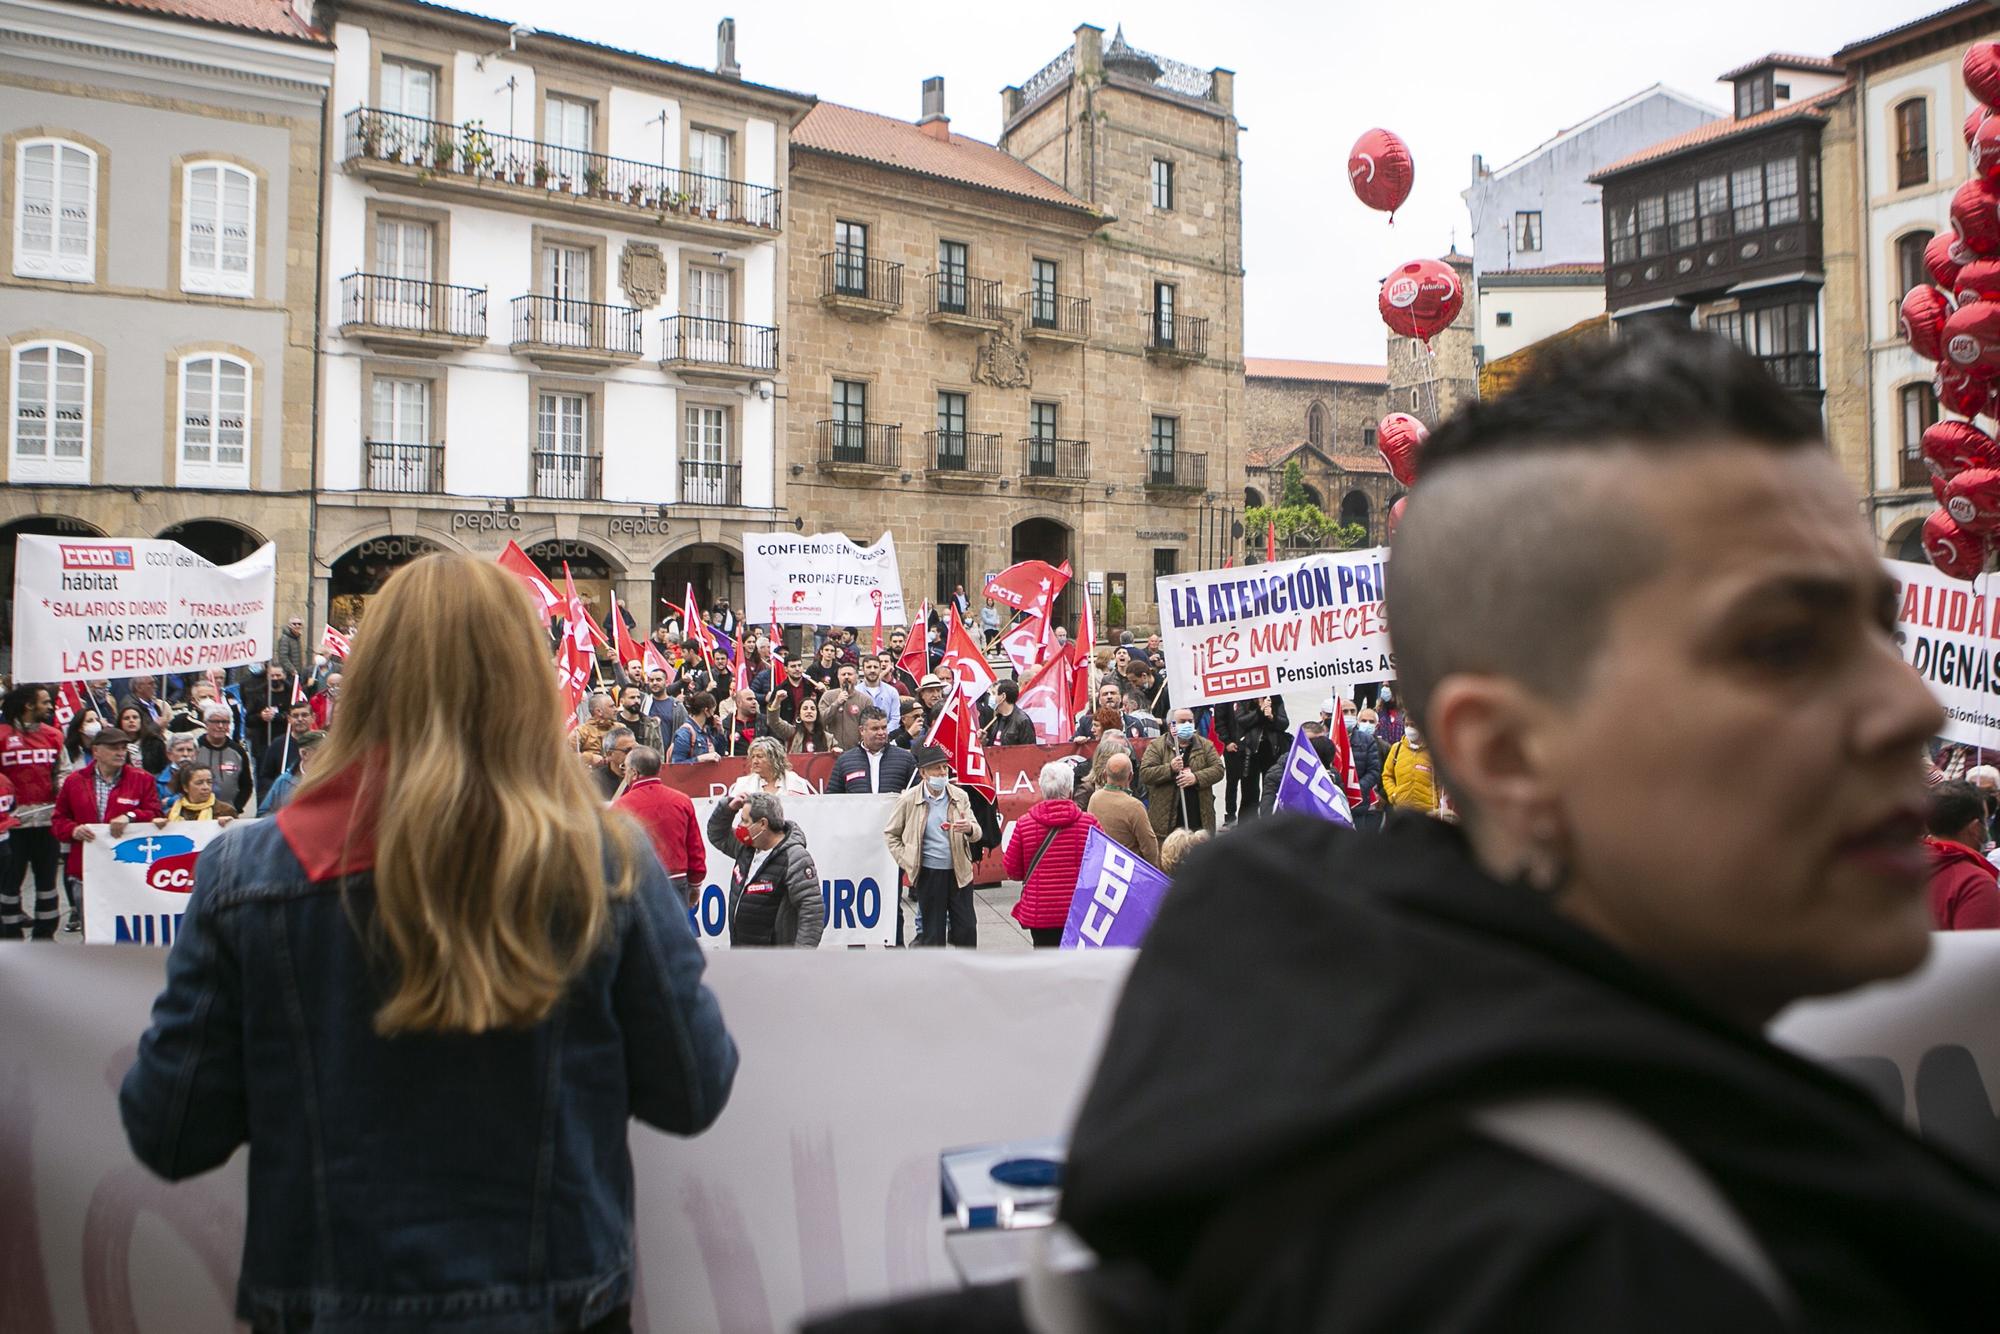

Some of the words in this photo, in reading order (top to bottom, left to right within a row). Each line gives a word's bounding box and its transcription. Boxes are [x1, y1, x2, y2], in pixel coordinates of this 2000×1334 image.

[1391, 281, 1415, 296] UGT
[452, 511, 522, 533] pepita
[608, 515, 671, 536] pepita
[63, 547, 115, 566] CCOO
[358, 536, 434, 560] pepita
[757, 543, 834, 556] CONFIEMOS
[836, 543, 850, 555] EN
[61, 572, 119, 591] hábitat
[788, 573, 836, 585] PROPIAS
[989, 583, 1023, 605] PCTE
[1170, 585, 1204, 629] LA
[1208, 562, 1333, 625] ATENCIÓN
[128, 600, 168, 616] DIGNOS
[1895, 580, 2000, 640] ALIDA
[88, 620, 124, 643] MÁS
[1250, 618, 1302, 658] MUY
[62, 650, 104, 674] LAS
[198, 638, 257, 664] PRIMERO
[1206, 669, 1266, 692] CCOO
[1276, 657, 1374, 684] Pensionistas
